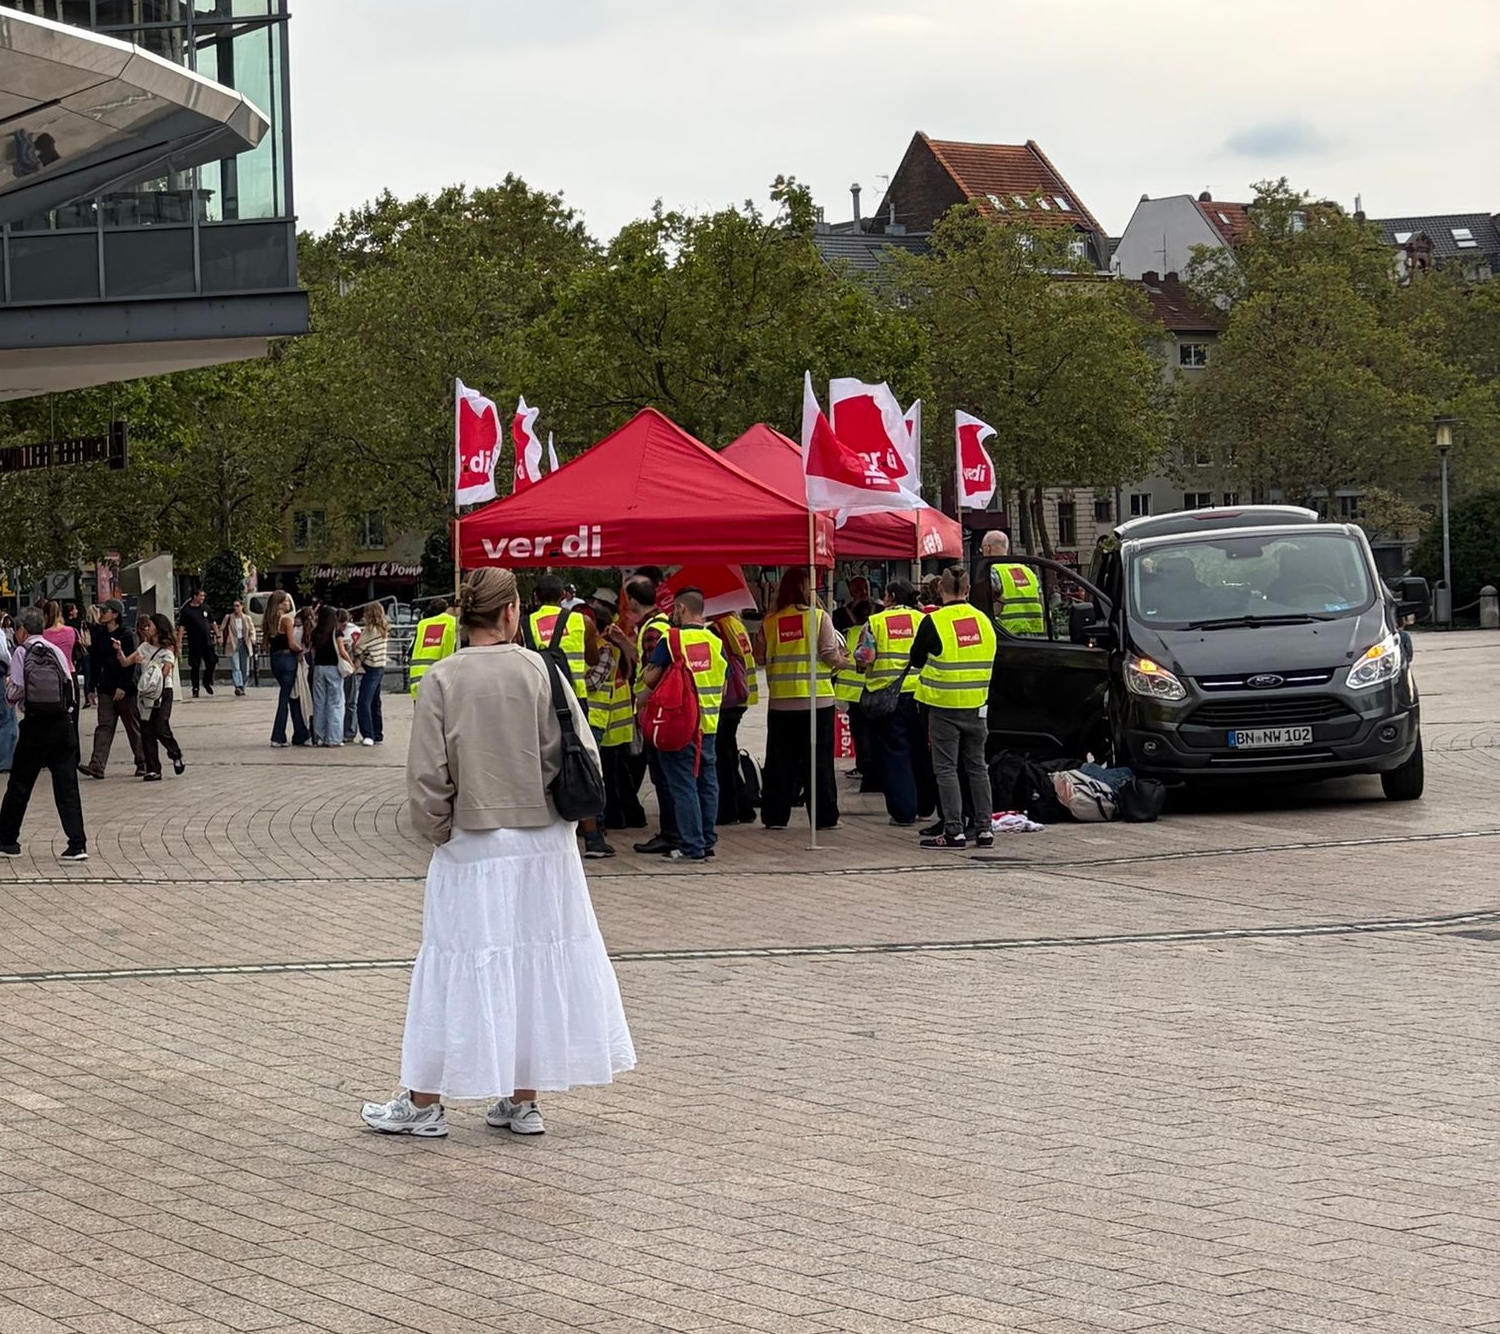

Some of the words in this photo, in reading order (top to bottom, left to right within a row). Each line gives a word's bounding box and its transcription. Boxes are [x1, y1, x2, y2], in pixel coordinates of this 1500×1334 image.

[481, 525, 602, 559] ver.di
[958, 633, 980, 642] ver.di
[1236, 731, 1254, 745] BN
[1263, 730, 1282, 744] NW
[1284, 728, 1311, 743] 102
